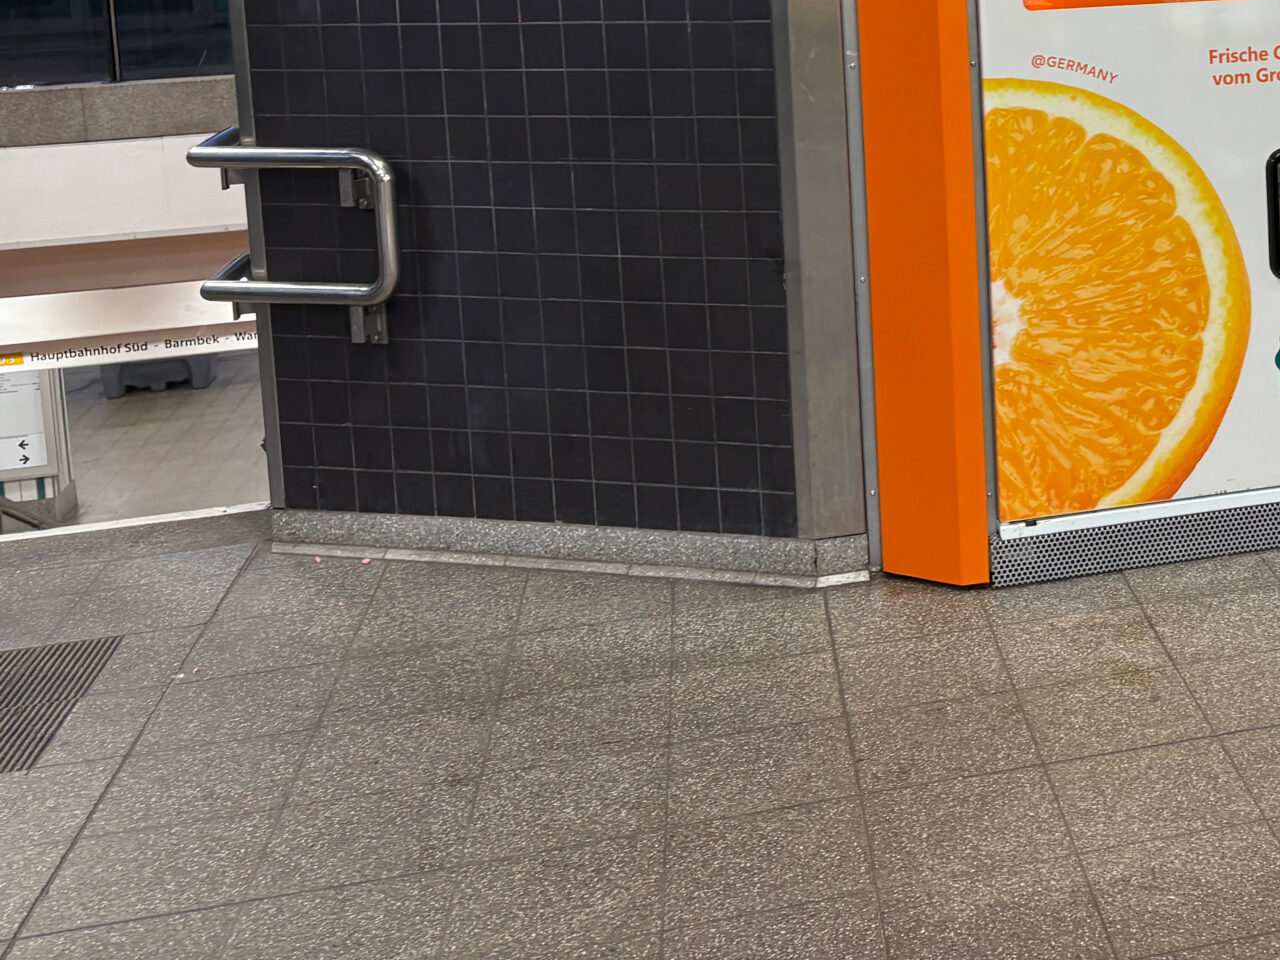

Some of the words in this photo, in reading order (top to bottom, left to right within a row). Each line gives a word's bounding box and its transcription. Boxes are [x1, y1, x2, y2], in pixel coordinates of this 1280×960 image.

[1209, 46, 1269, 64] Frische
[1031, 54, 1119, 84] @GERMANY
[1212, 71, 1251, 86] vom
[30, 343, 122, 362] Hauptbahnhof
[124, 342, 148, 353] Süd
[164, 334, 220, 349] Barmbek
